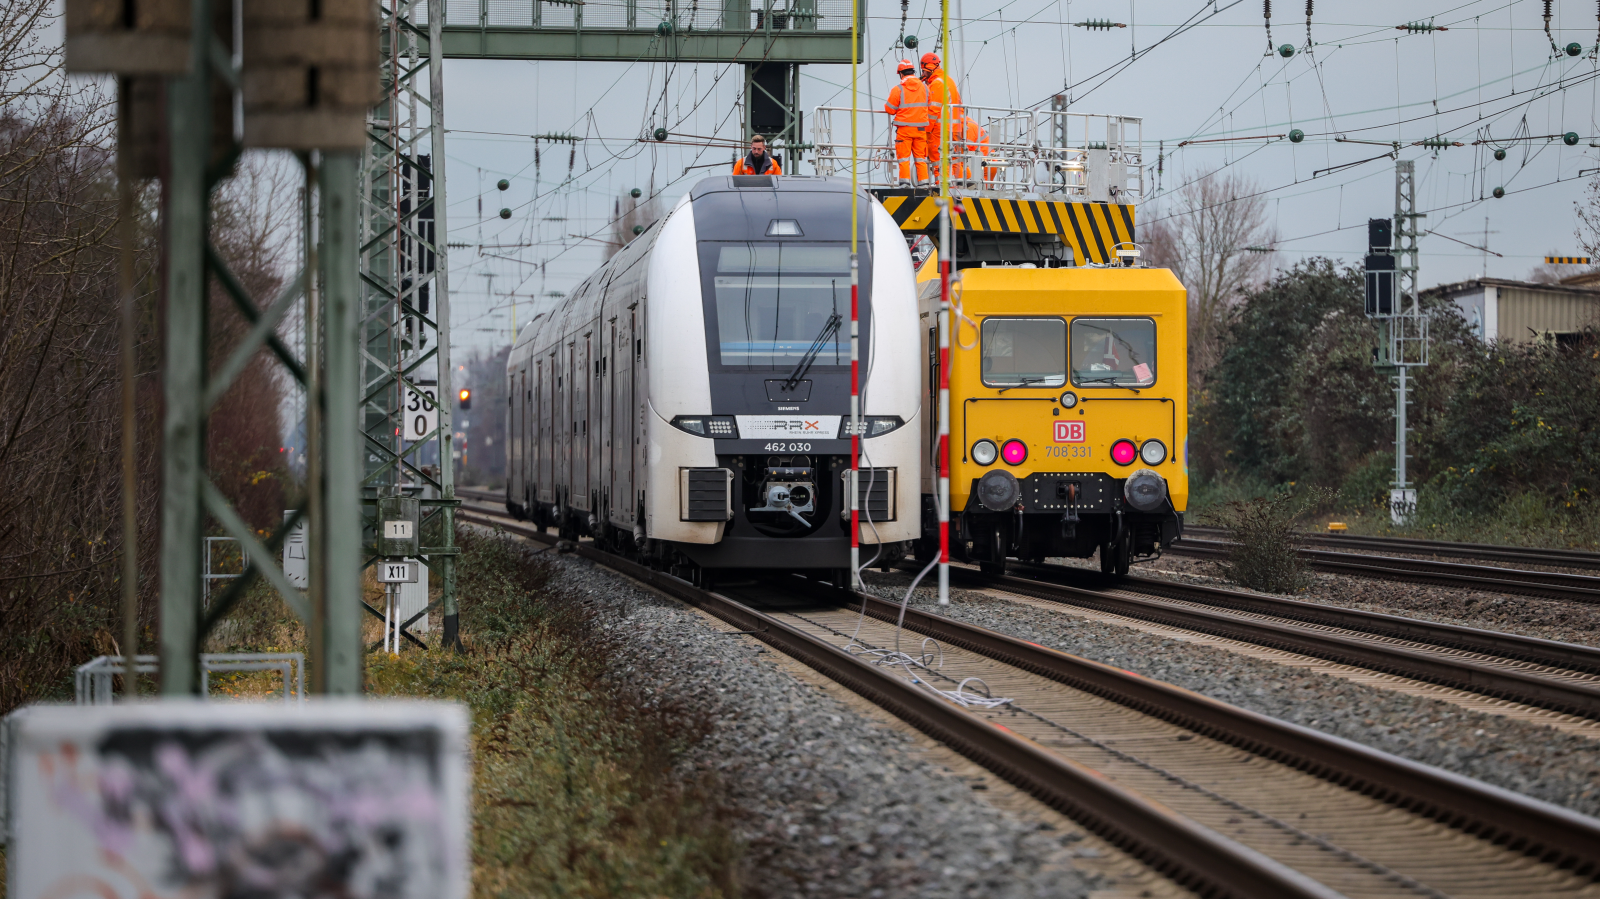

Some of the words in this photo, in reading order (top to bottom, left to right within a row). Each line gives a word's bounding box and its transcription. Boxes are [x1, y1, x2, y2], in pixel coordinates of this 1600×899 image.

[408, 390, 435, 412] 30
[414, 414, 428, 436] 0
[1058, 424, 1082, 440] DB
[764, 442, 786, 452] 462
[789, 442, 812, 452] 030
[1046, 446, 1068, 458] 708
[1072, 446, 1092, 458] 331
[394, 524, 404, 534] 11
[388, 566, 405, 578] X11
